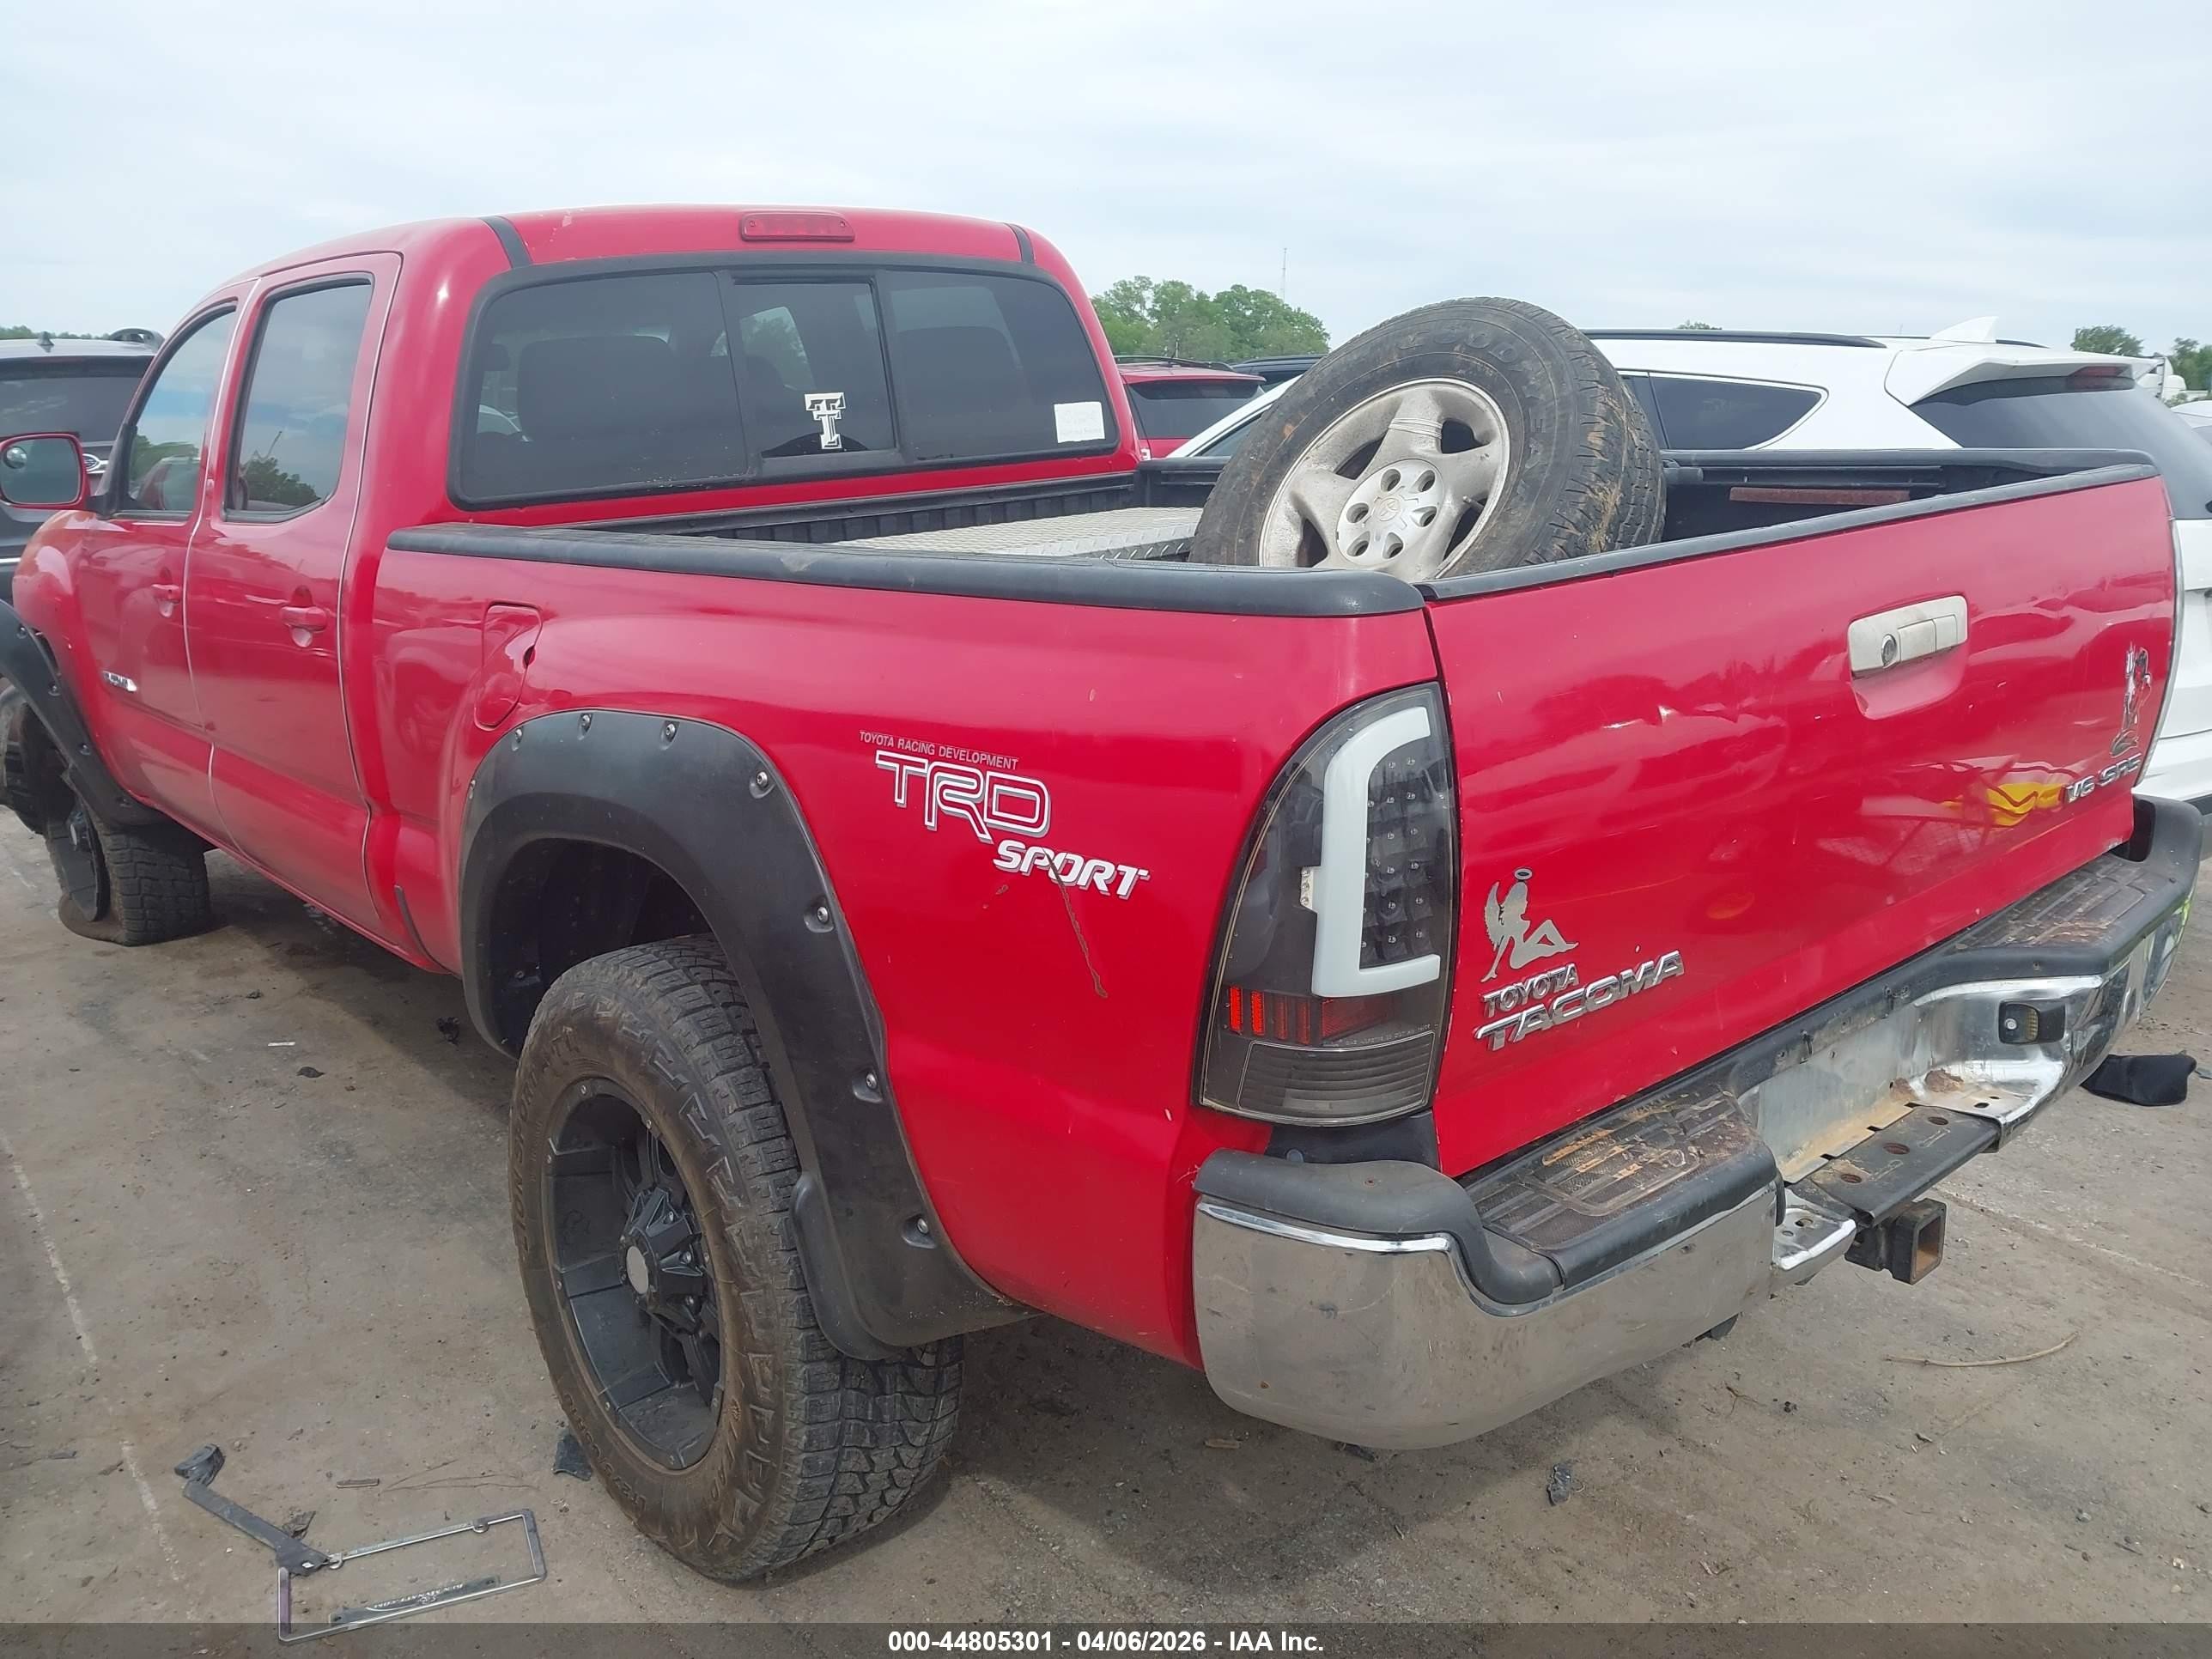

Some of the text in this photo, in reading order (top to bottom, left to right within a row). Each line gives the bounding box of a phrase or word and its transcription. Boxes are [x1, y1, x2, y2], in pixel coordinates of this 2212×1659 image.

[860, 731, 1019, 771] TOYOTA RACING DEVELOPMENT
[875, 749, 1052, 845] TRD
[2064, 775, 2095, 804] V6
[993, 839, 1151, 901] SPORT
[1474, 950, 1685, 1052] TACOMA
[1480, 963, 1580, 1018] TOYOTA
